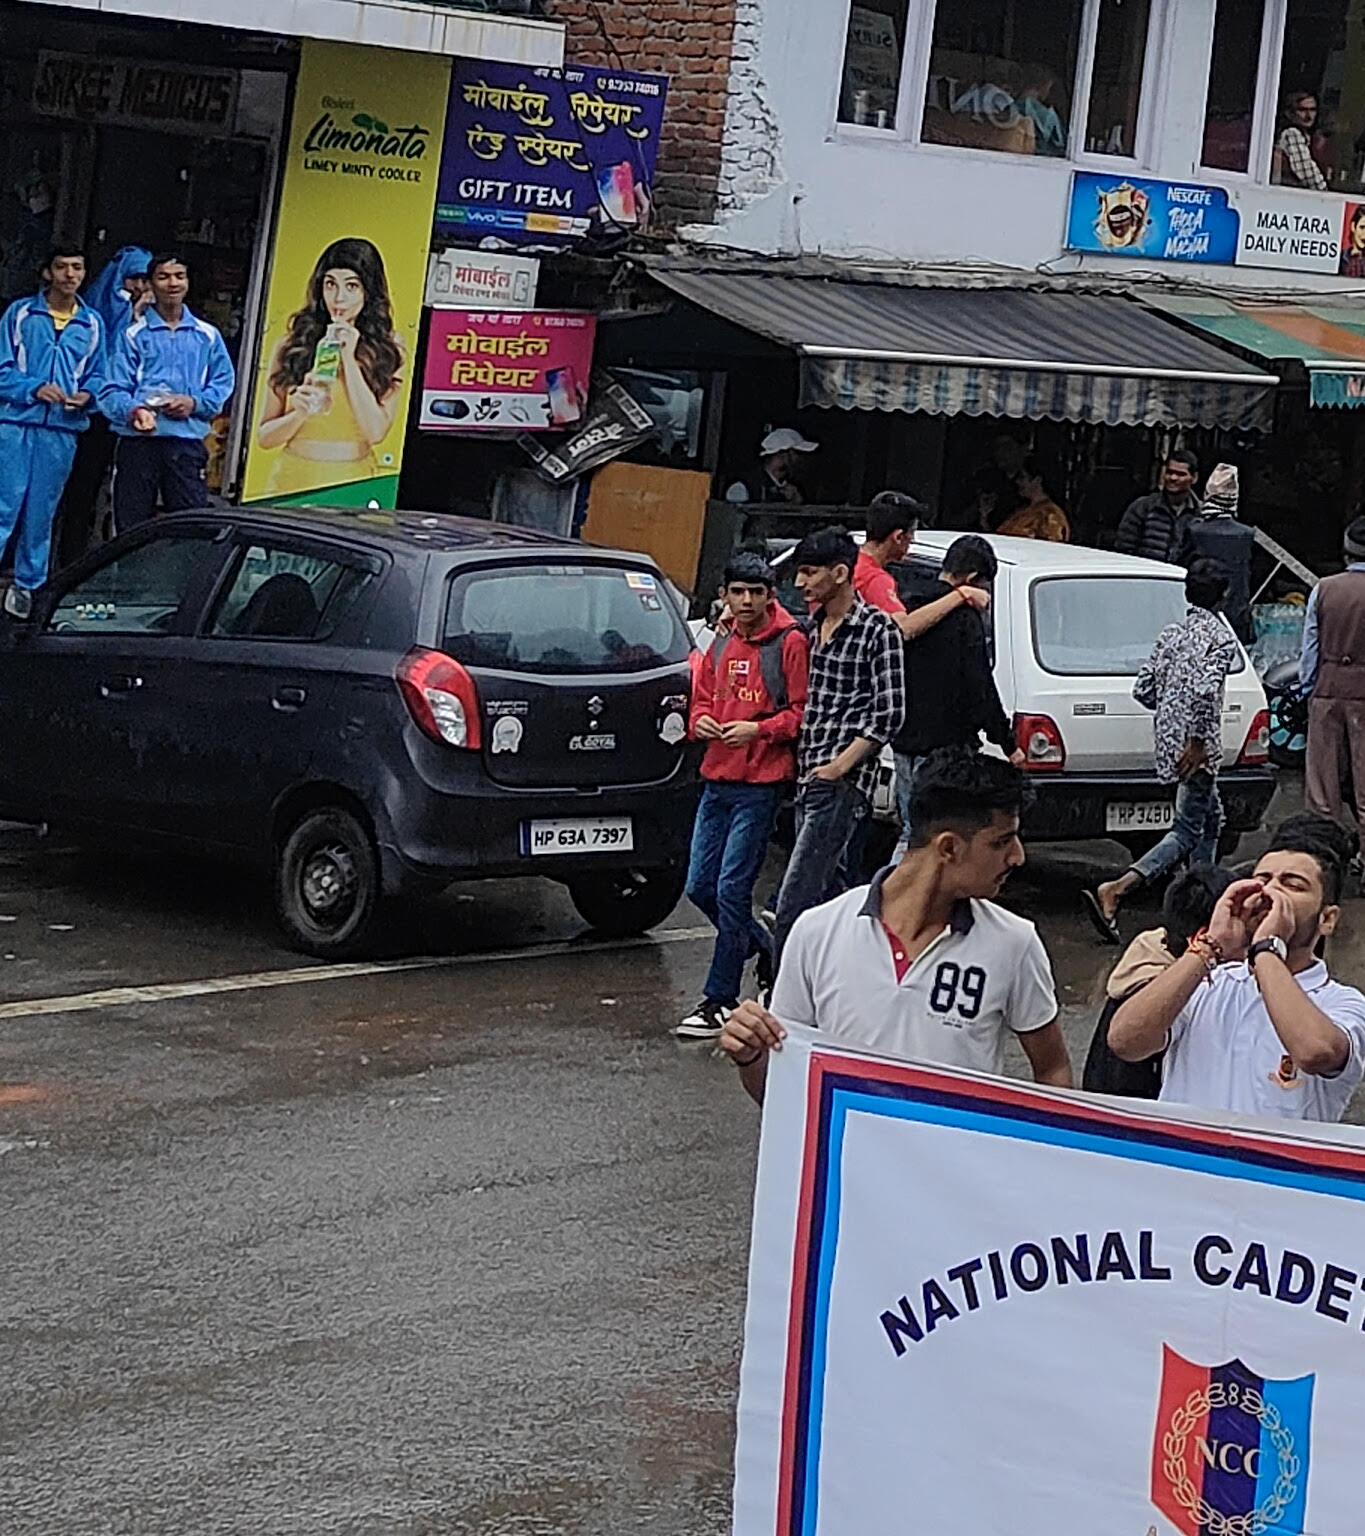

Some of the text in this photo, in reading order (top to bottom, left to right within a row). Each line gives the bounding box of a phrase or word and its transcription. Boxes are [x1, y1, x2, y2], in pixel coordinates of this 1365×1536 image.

[304, 112, 430, 160] Limonata
[304, 157, 421, 182] LIMEY MINTY COOLER
[459, 178, 572, 209] GIFT ITEM
[1257, 211, 1331, 235] MAA TARA
[1244, 233, 1338, 259] DAILY NEEDS
[451, 360, 541, 388] रिपेयर
[534, 827, 628, 846] HP 63A 7397
[930, 961, 987, 1020] 89
[879, 1229, 1172, 1357] NATIONAL
[1194, 1436, 1264, 1479] NCC
